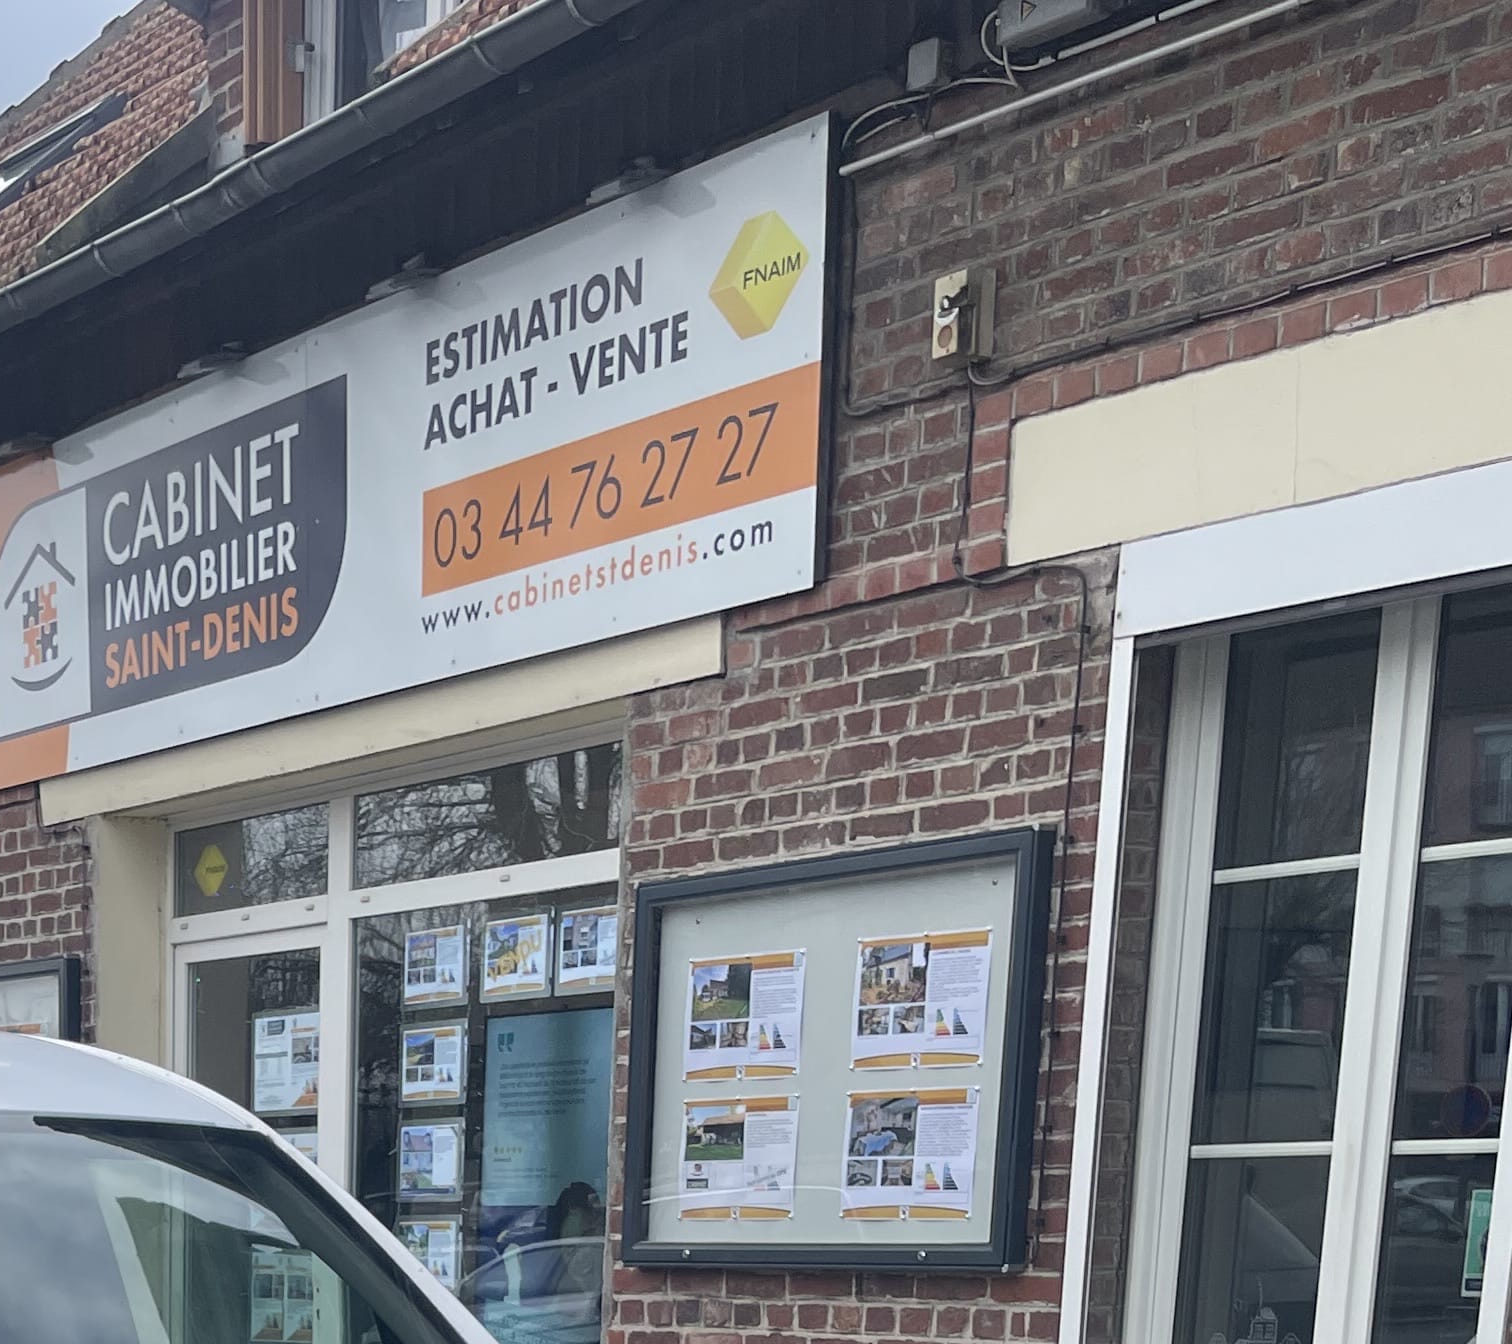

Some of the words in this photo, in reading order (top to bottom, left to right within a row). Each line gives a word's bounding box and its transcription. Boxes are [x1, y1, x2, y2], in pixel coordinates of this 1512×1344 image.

[425, 256, 644, 386] ESTIMATION
[743, 251, 801, 290] FNAIM
[424, 366, 538, 450] ACHAT
[568, 310, 689, 396] VENTE
[102, 423, 300, 566] CABINET
[433, 498, 483, 569] 03
[497, 474, 554, 547] 44
[568, 452, 623, 530] 76
[639, 427, 700, 509] 27
[715, 401, 780, 487] 27
[104, 520, 297, 631] IMMOBILIER
[421, 518, 774, 635] www.cabinetstdenis.com
[105, 586, 299, 690] SAINT-DENIS
